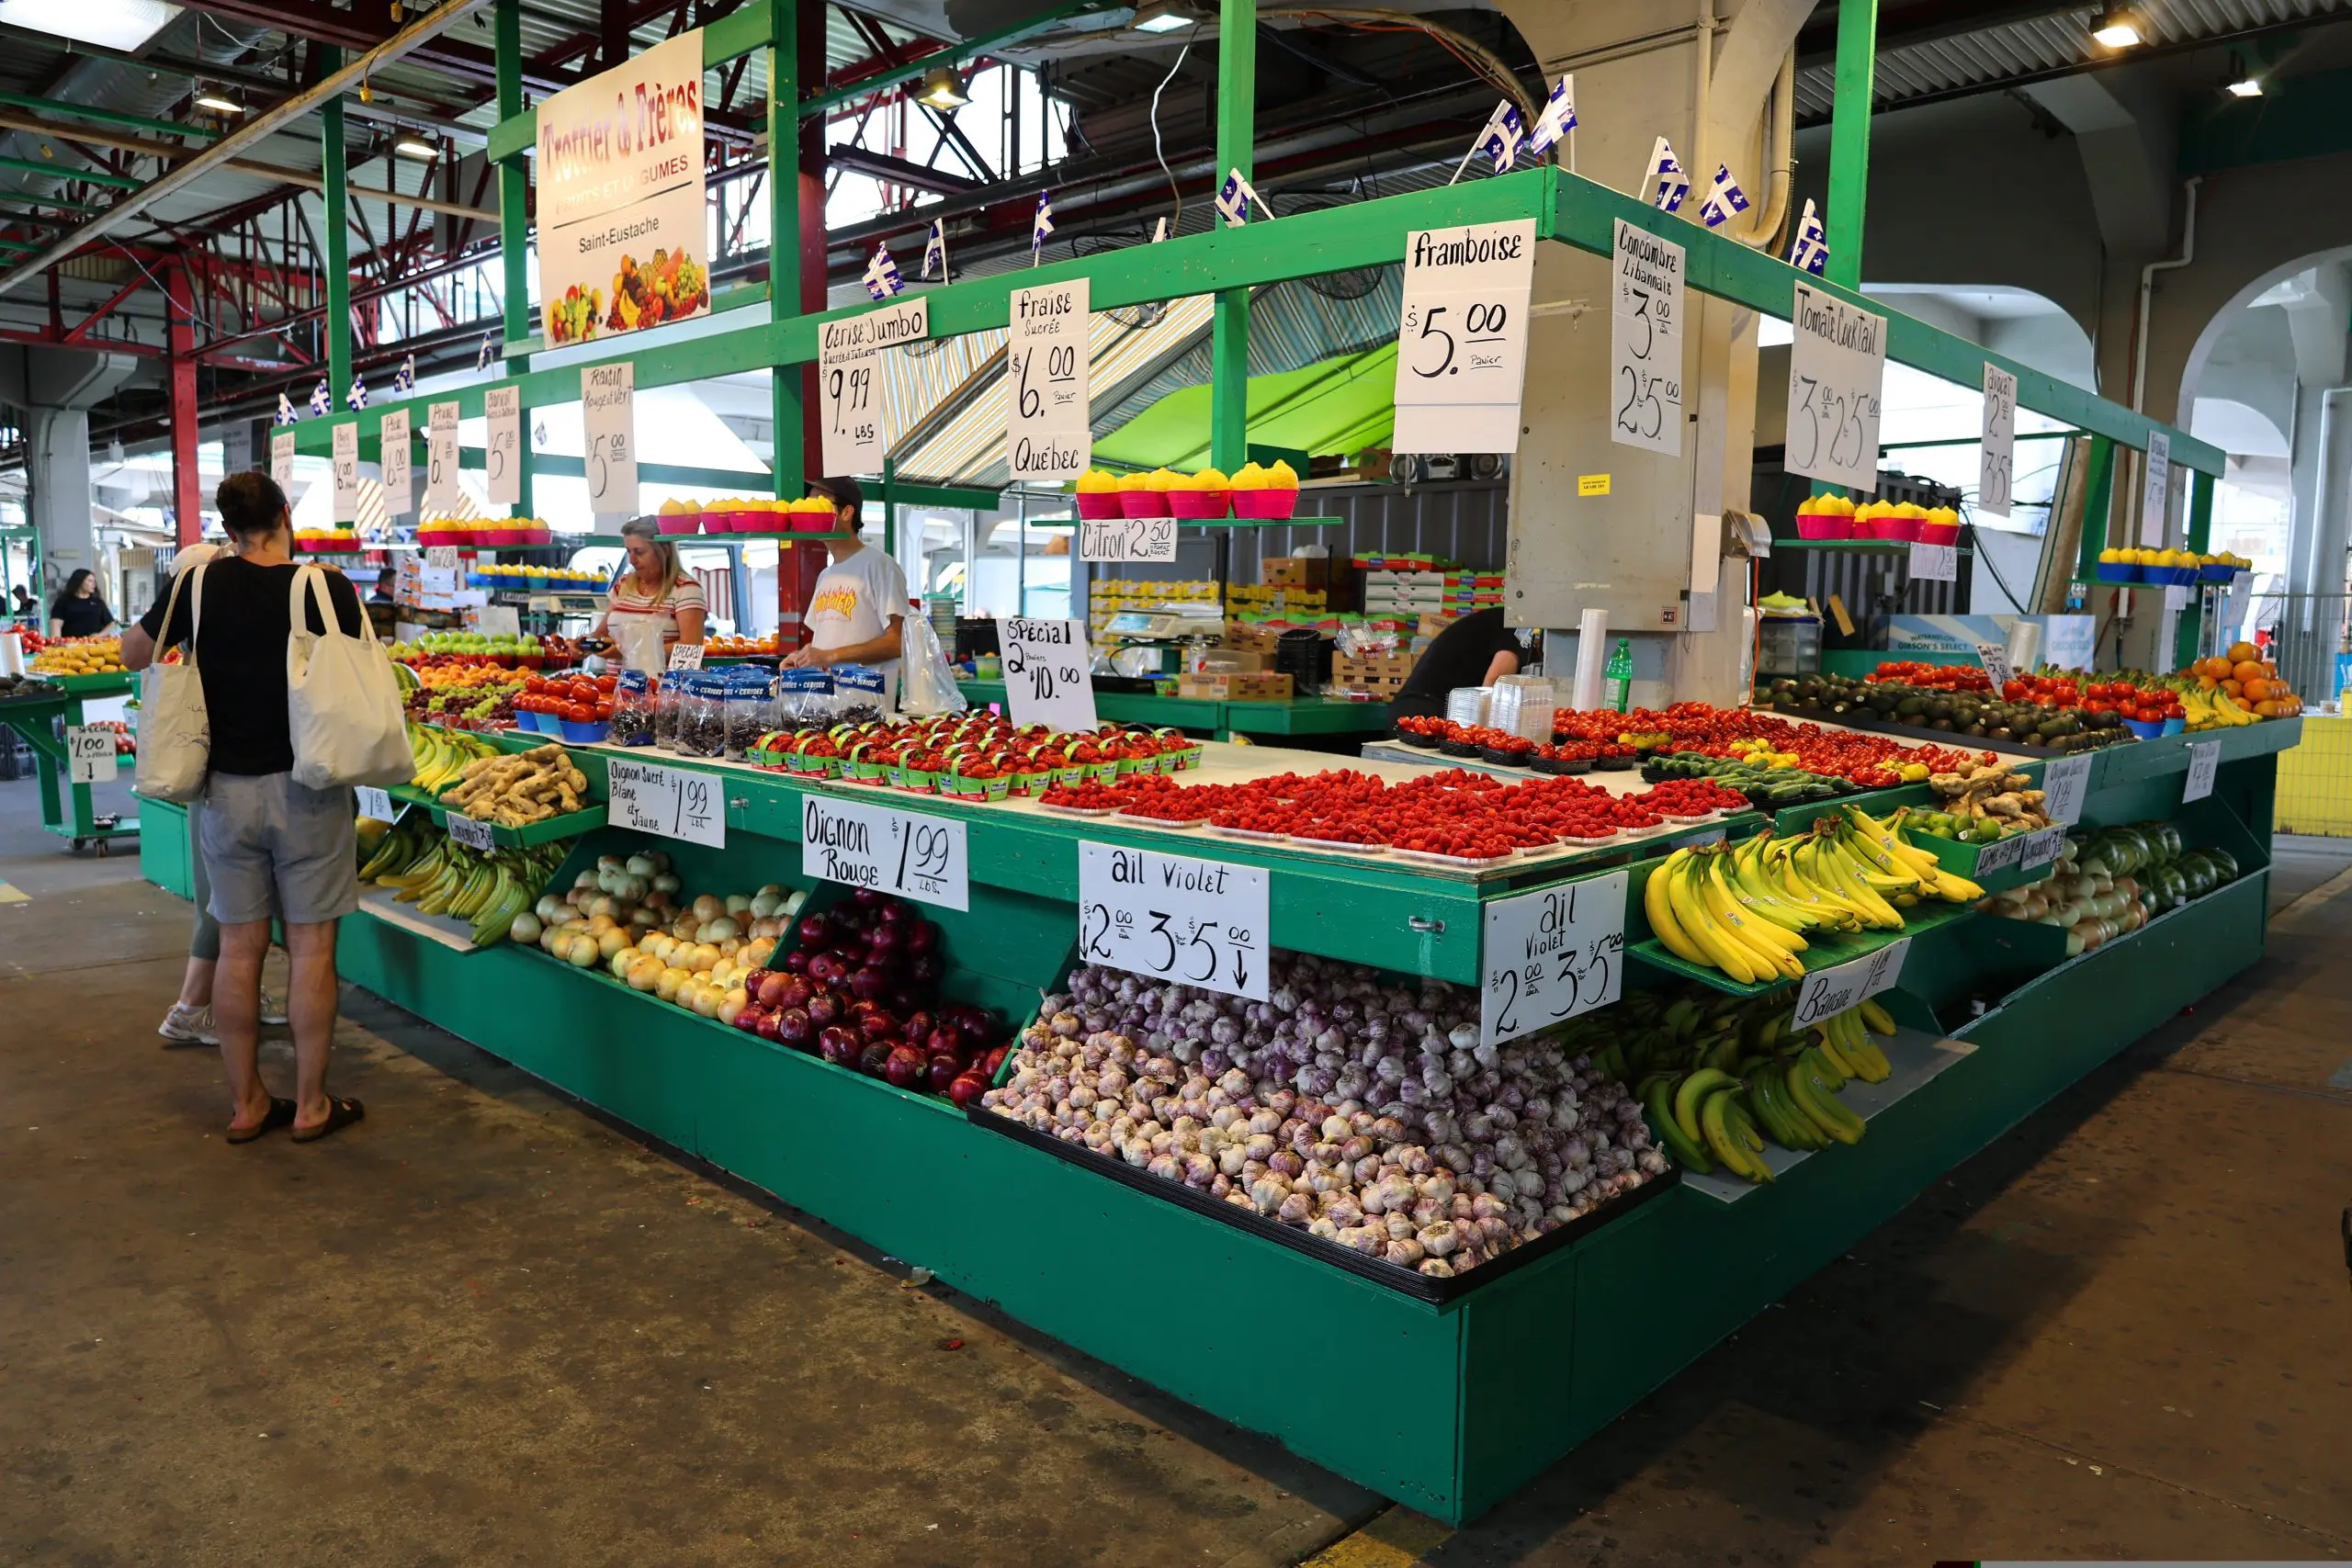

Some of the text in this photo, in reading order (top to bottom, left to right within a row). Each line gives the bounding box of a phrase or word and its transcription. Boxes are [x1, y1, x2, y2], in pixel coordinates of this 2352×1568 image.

[617, 92, 631, 159] &
[635, 80, 698, 152] Frères
[579, 216, 660, 254] Saint-Eustache
[1415, 229, 1521, 267] framboise
[1619, 223, 1677, 273] Concombre
[825, 309, 922, 349] Cerise Jumbo
[1797, 288, 1836, 343] Tomate
[1015, 436, 1079, 472] Québec
[1081, 521, 1125, 559] Citron
[1008, 642, 1026, 673] 2
[1897, 642, 1968, 651] GIBSON'S SELECT
[1910, 634, 1955, 643] WATERMELON
[610, 761, 640, 784] Oignon
[631, 808, 660, 831] Jaune
[806, 800, 870, 856] Oignon
[820, 848, 879, 887] Rouge
[1112, 850, 1146, 885] ail
[1541, 886, 1575, 932] ail
[1144, 909, 1176, 972] 3
[1550, 950, 1577, 1017] 3
[1798, 977, 1852, 1021] Banane
